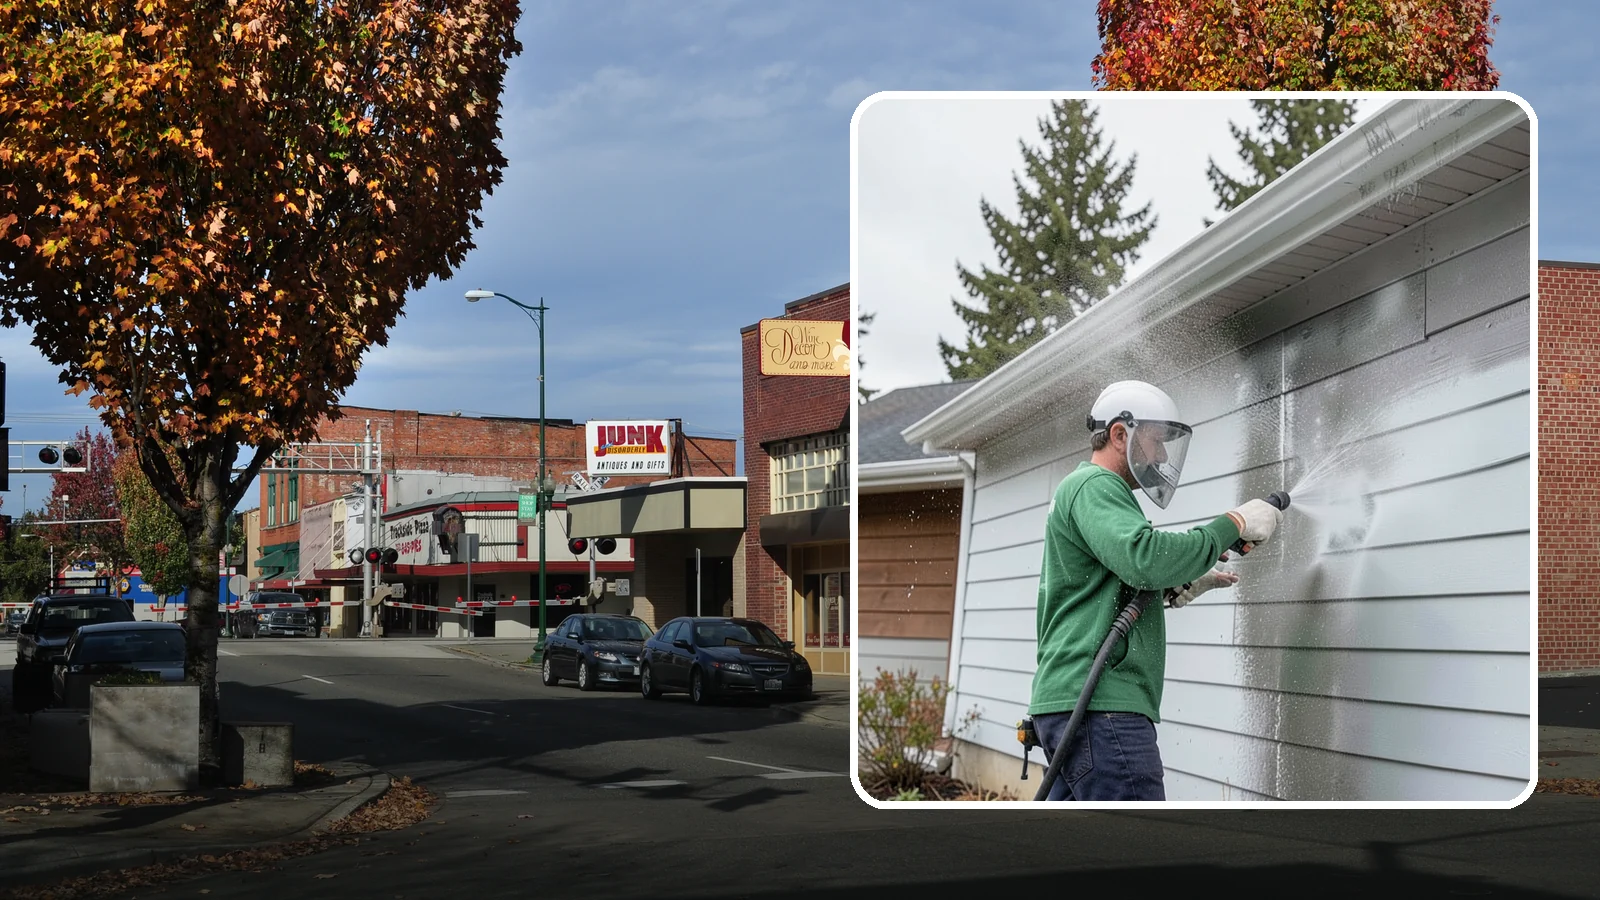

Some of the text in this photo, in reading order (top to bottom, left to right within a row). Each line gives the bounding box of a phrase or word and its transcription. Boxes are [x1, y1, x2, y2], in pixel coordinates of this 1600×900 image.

[595, 425, 666, 457] JUNK
[607, 446, 646, 454] DISORDERLY
[597, 460, 666, 470] ANTIQUES AND GIFTS
[414, 519, 429, 535] Pizza
